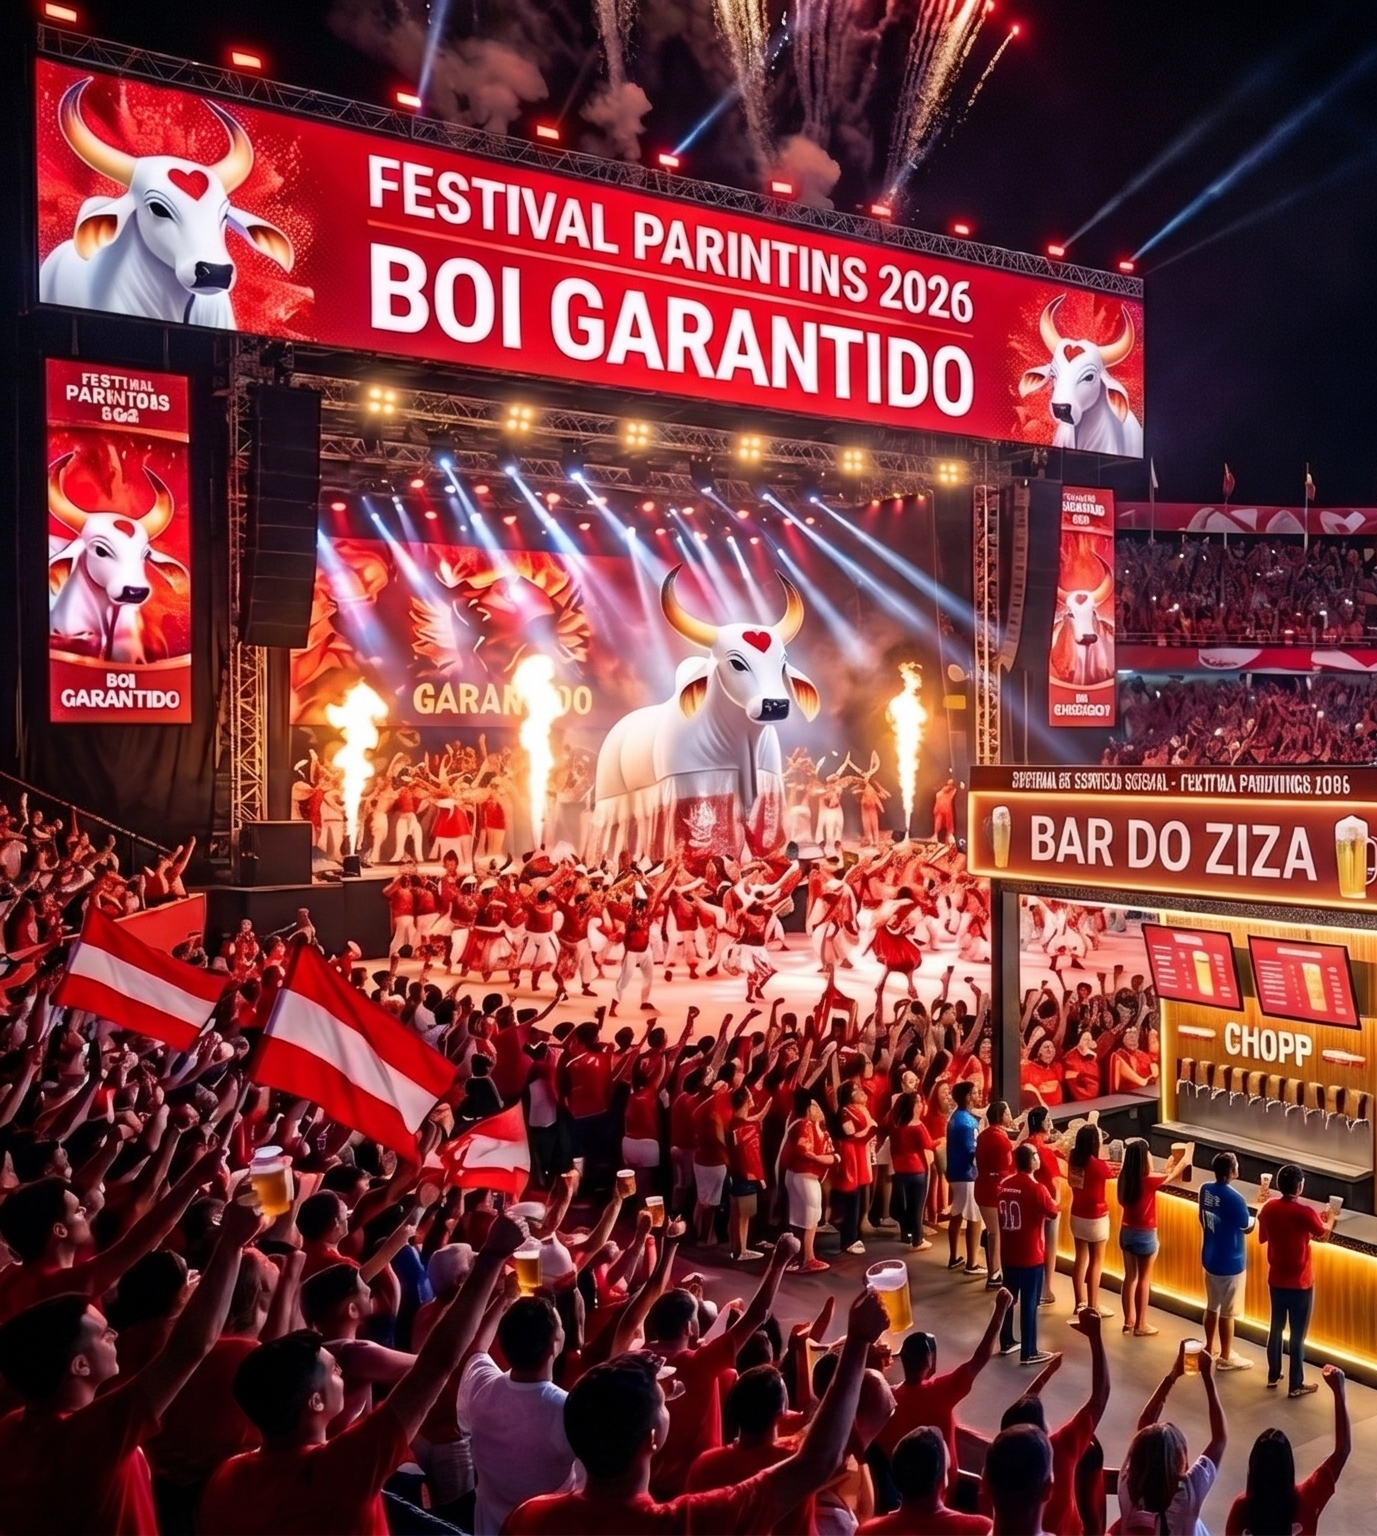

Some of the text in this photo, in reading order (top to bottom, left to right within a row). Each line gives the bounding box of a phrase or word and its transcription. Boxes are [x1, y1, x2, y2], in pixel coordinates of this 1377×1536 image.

[367, 154, 975, 323] FESTIVAL PARINTINS 2026
[369, 242, 974, 417] BOI GARANTIDO
[61, 688, 180, 709] GARANTIDO
[413, 682, 593, 716] GARANDO
[1031, 815, 1318, 882] BAR DO ZIZA
[1224, 1021, 1313, 1067] CHOPP
